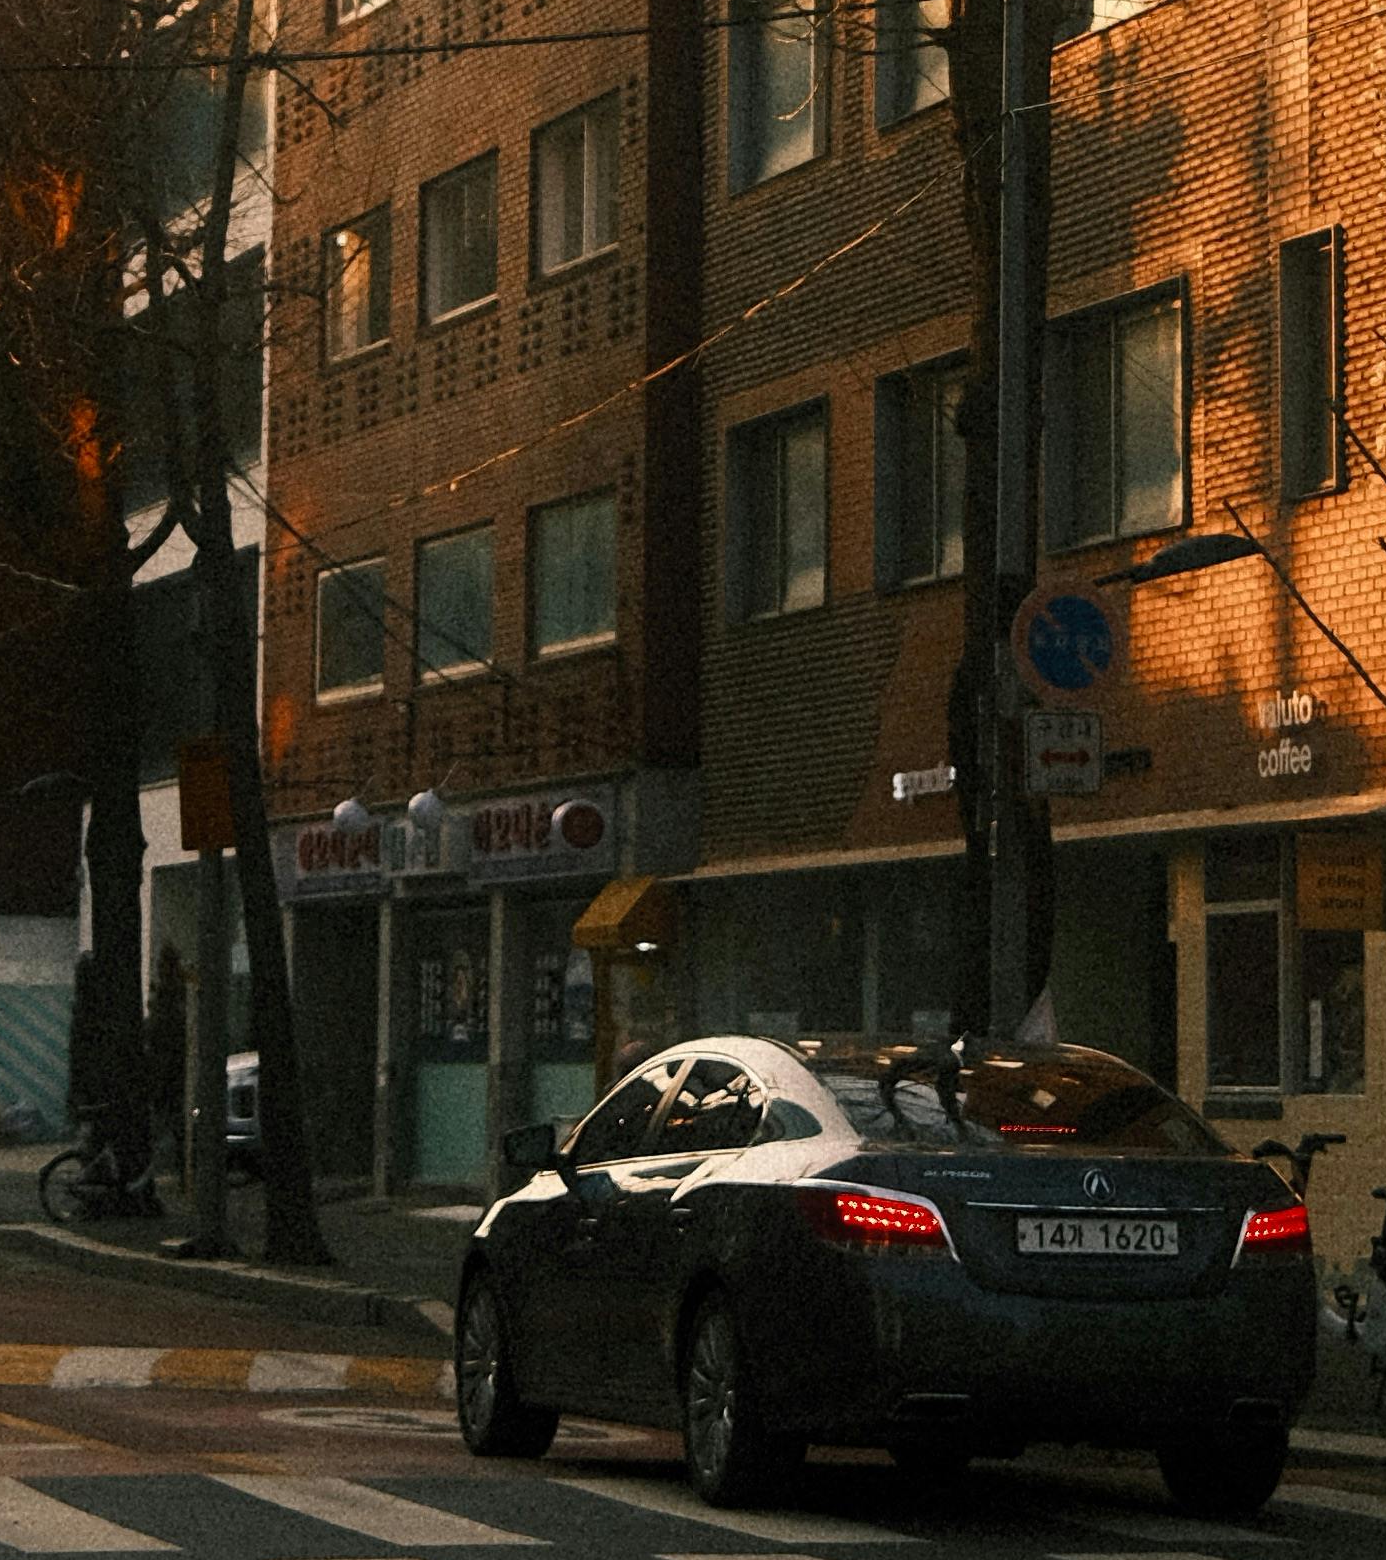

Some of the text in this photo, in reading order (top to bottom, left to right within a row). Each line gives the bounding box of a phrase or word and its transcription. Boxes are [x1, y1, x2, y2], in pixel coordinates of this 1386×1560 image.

[1257, 738, 1313, 778] coffee
[1033, 1222, 1166, 1251] 14가 1620
